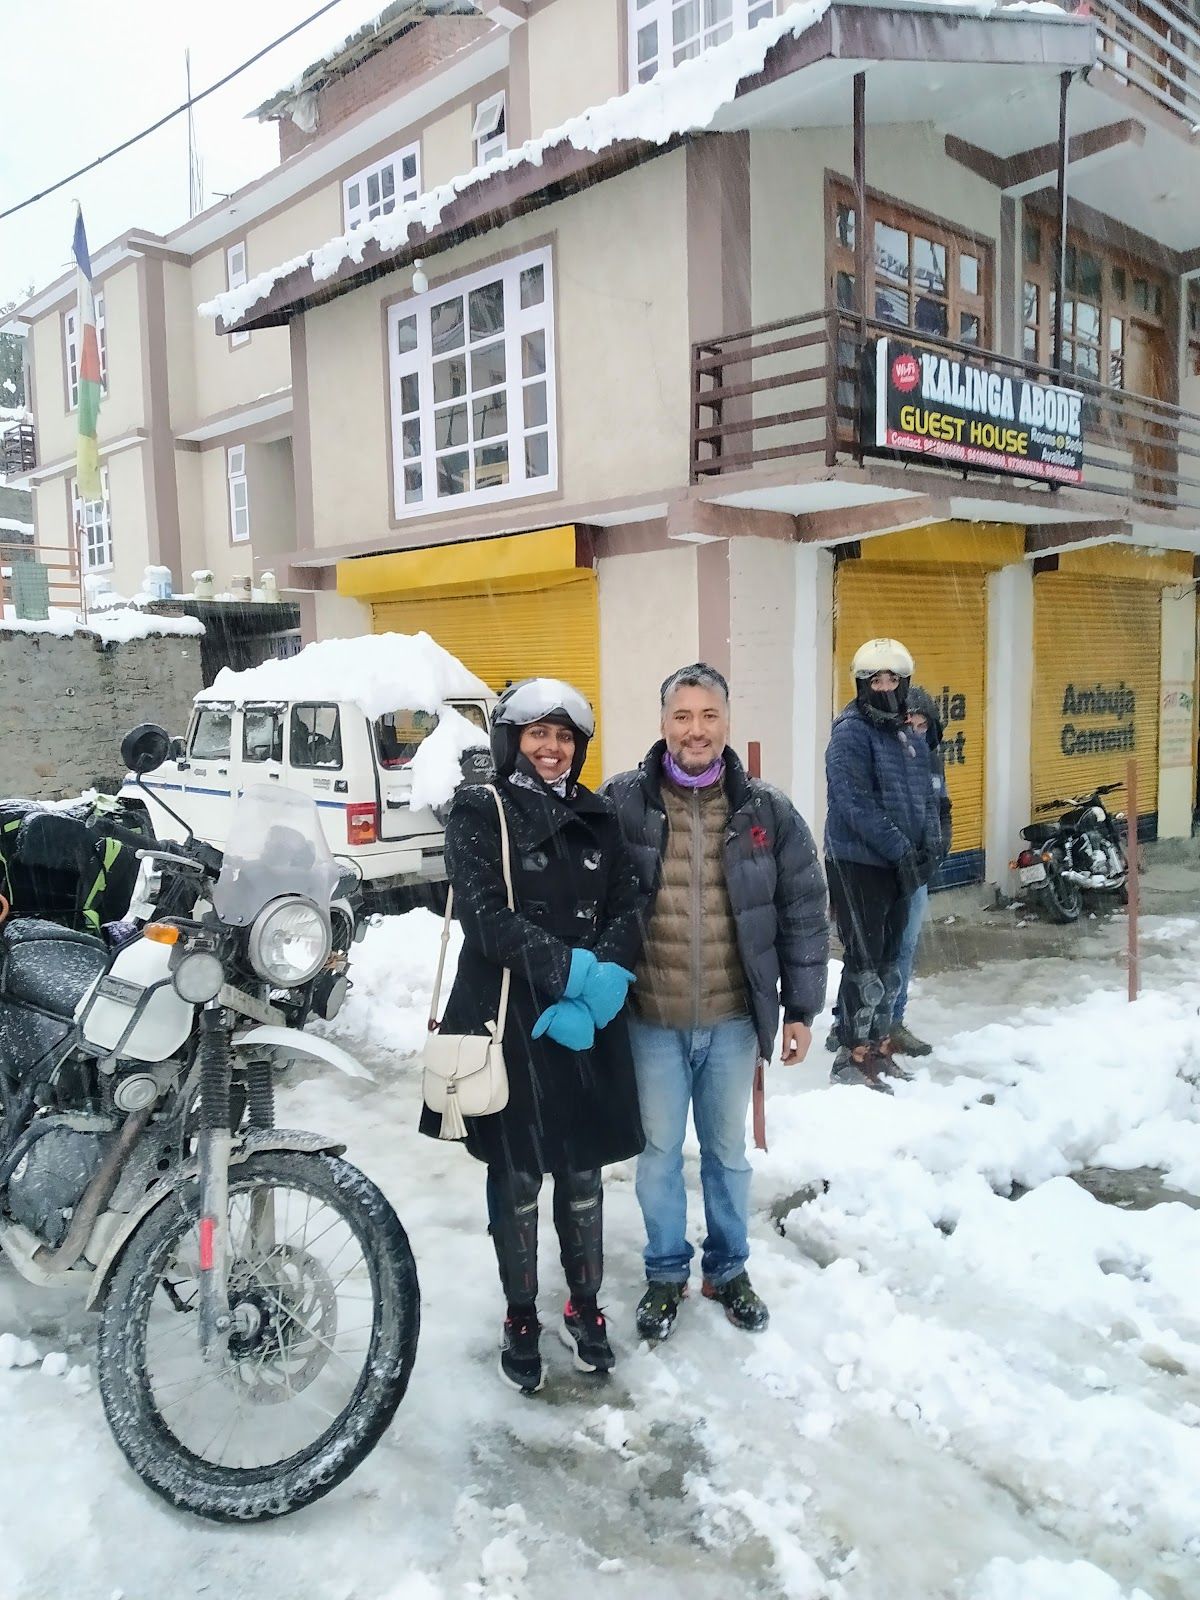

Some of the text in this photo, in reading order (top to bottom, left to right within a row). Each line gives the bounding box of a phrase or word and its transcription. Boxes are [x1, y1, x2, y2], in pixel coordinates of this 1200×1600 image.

[921, 352, 1081, 437] KALINGA ABODE
[901, 405, 966, 443] GUEST
[970, 420, 1029, 455] HOUSE
[1062, 681, 1136, 720] Ambuja
[1061, 723, 1136, 756] Cement
